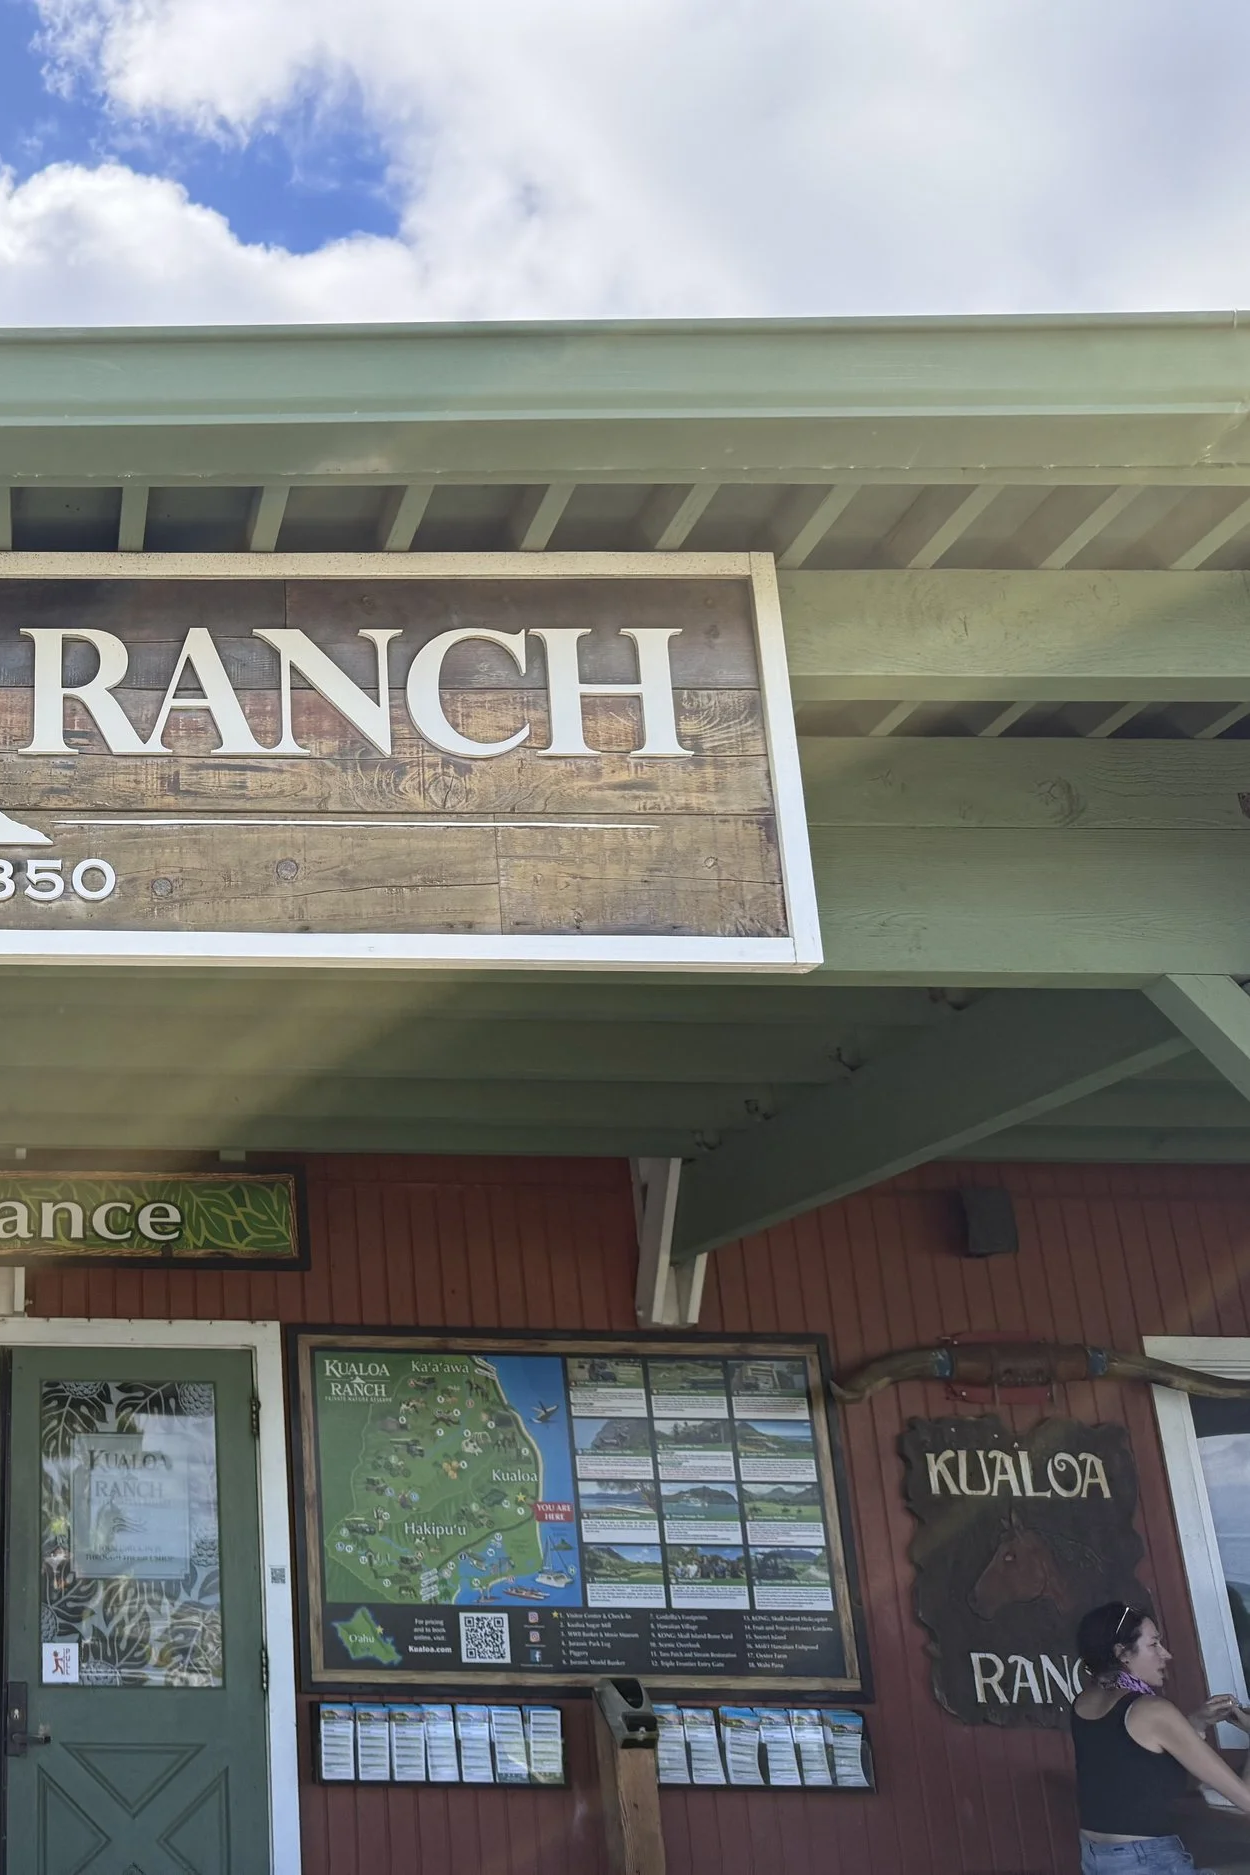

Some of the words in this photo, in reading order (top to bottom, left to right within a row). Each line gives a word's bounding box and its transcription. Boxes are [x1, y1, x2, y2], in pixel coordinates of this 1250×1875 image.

[18, 626, 694, 758] RANCH
[324, 1359, 390, 1377] KUALOA
[331, 1382, 385, 1395] RANCH
[492, 1469, 539, 1482] Kualoa
[925, 1449, 1112, 1499] KUALOA
[95, 1481, 164, 1498] RANCH
[536, 1503, 554, 1512] YOU
[555, 1504, 571, 1512] ARE
[544, 1513, 565, 1521] HERE
[408, 1645, 452, 1654] Kualoa.com
[970, 1652, 1084, 1705] RANC
